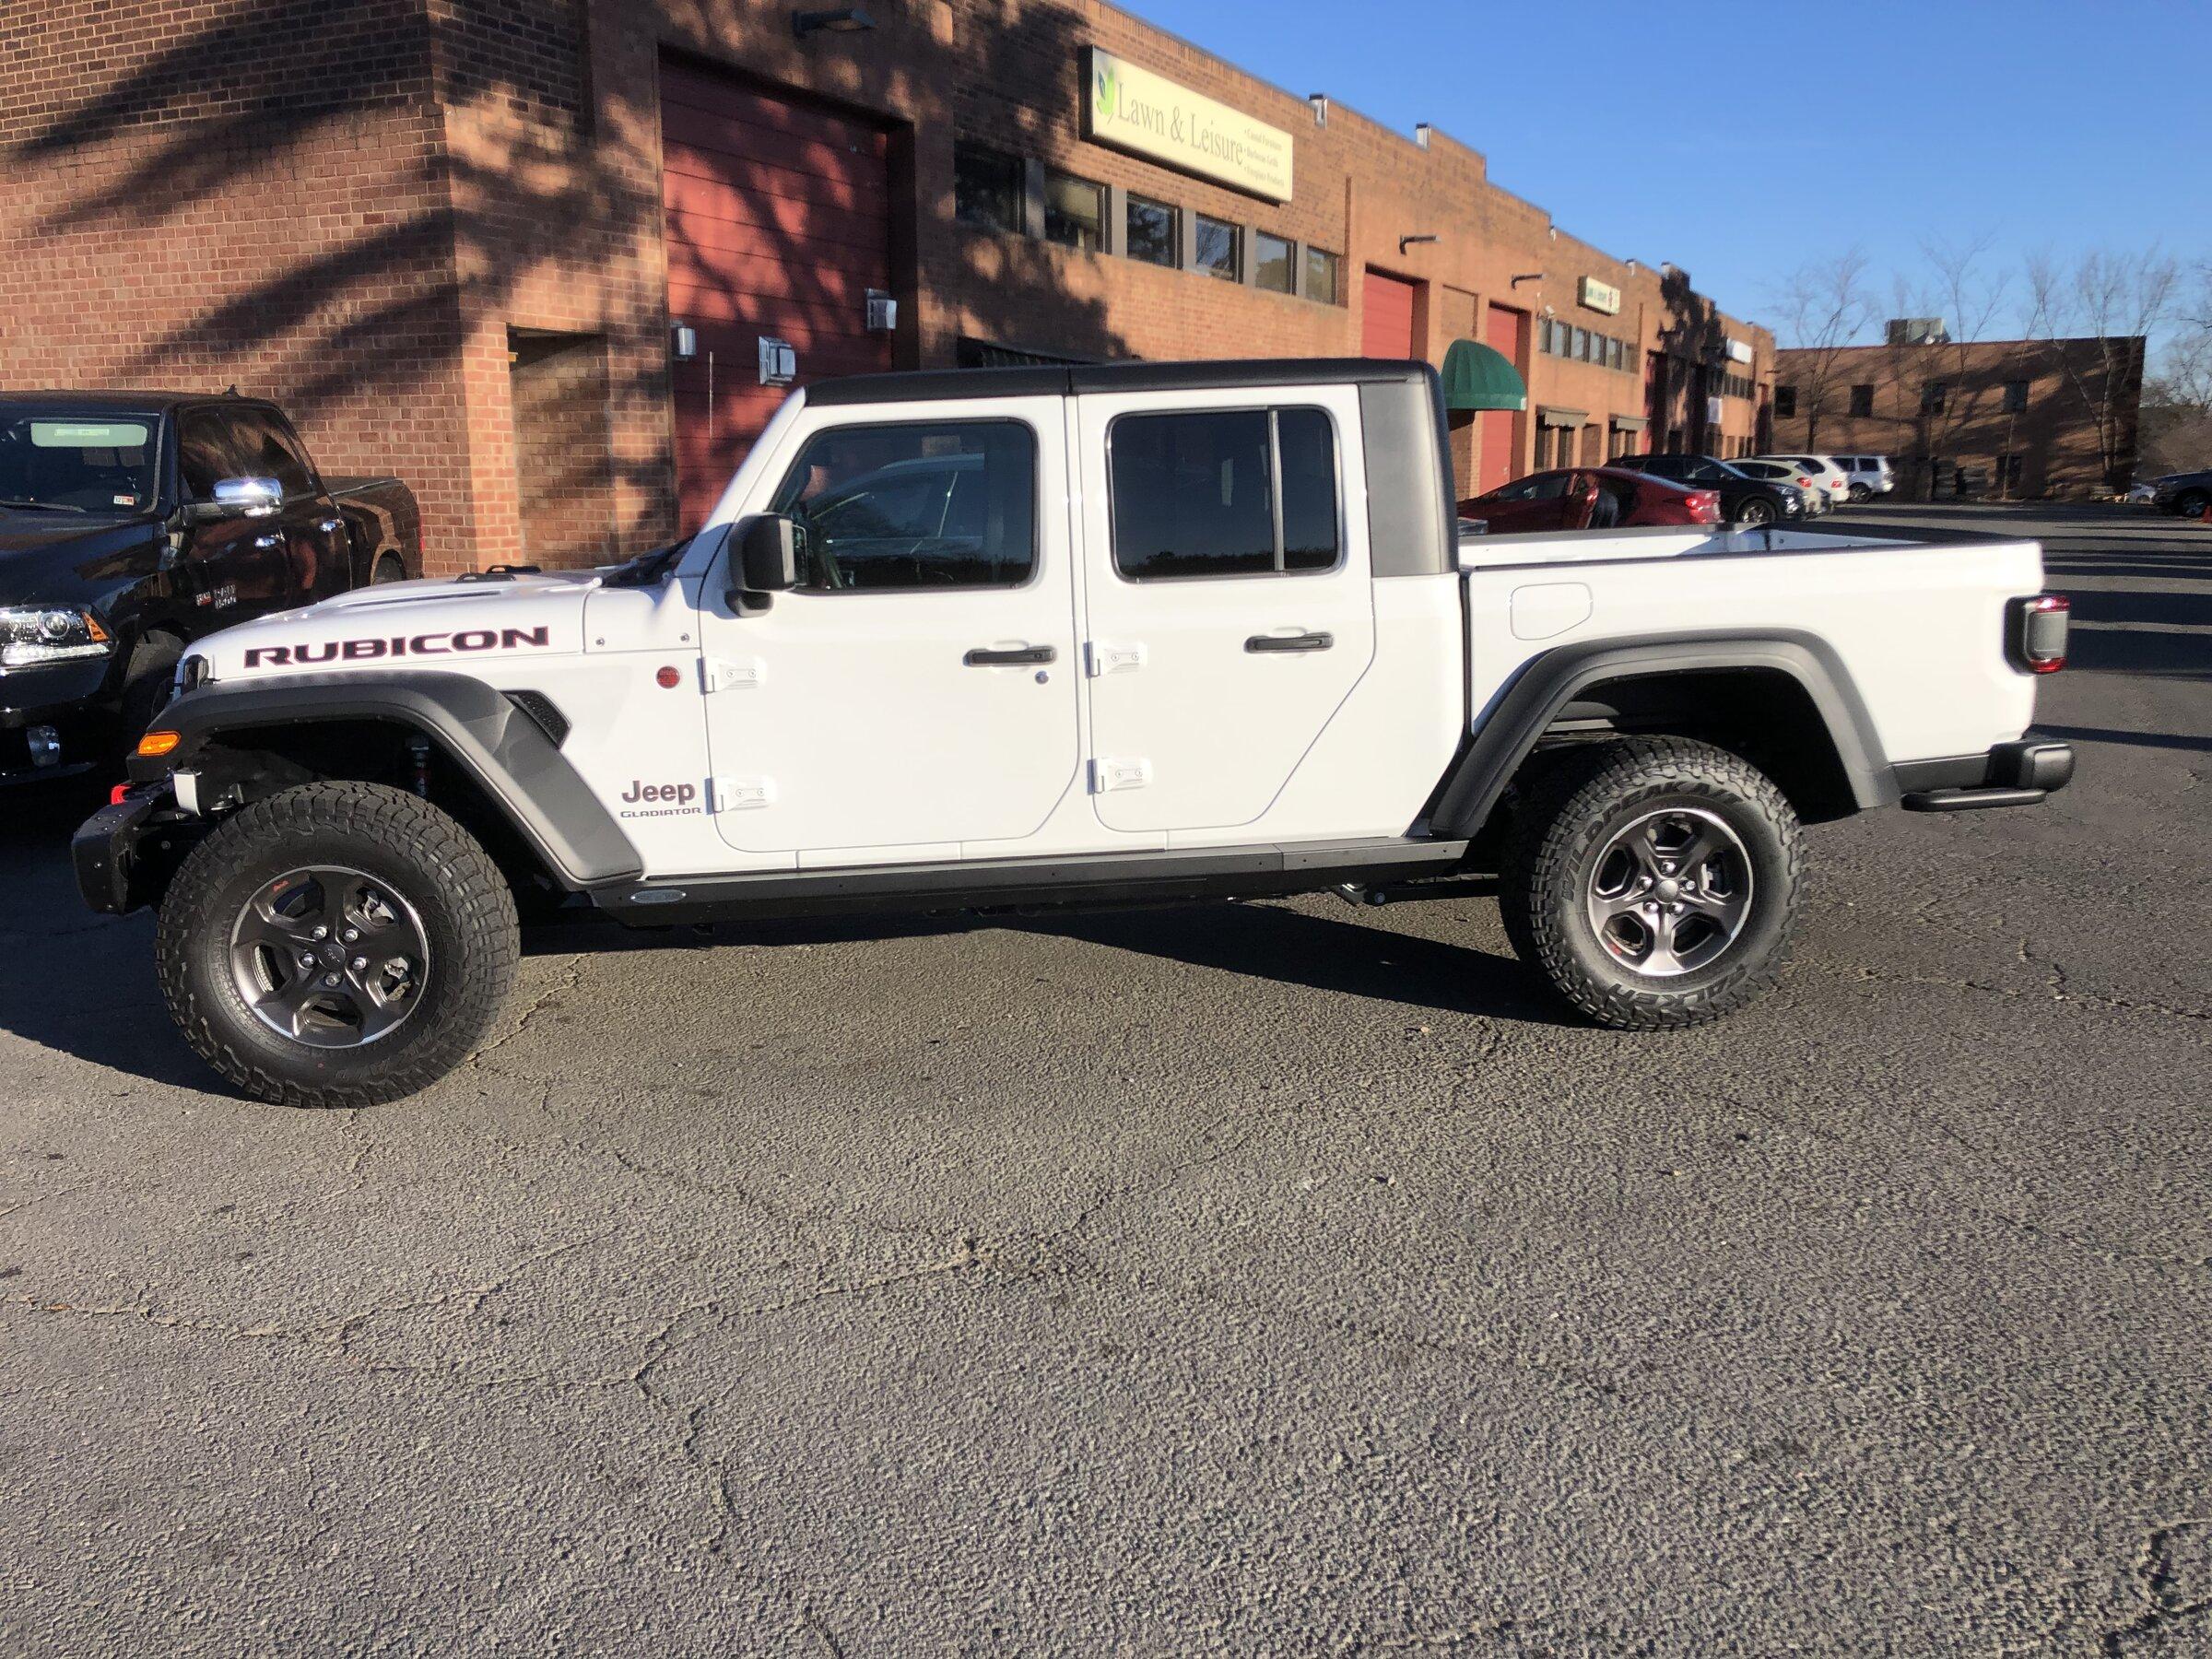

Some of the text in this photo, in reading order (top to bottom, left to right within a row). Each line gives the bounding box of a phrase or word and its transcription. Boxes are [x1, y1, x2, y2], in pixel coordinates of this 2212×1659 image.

[1118, 82, 1164, 136] Lawn
[1170, 105, 1185, 144] &
[1190, 112, 1243, 166] Leisure
[243, 626, 549, 669] RUBICON
[621, 780, 696, 806] Jeep
[620, 807, 701, 818] GLADIATOR
